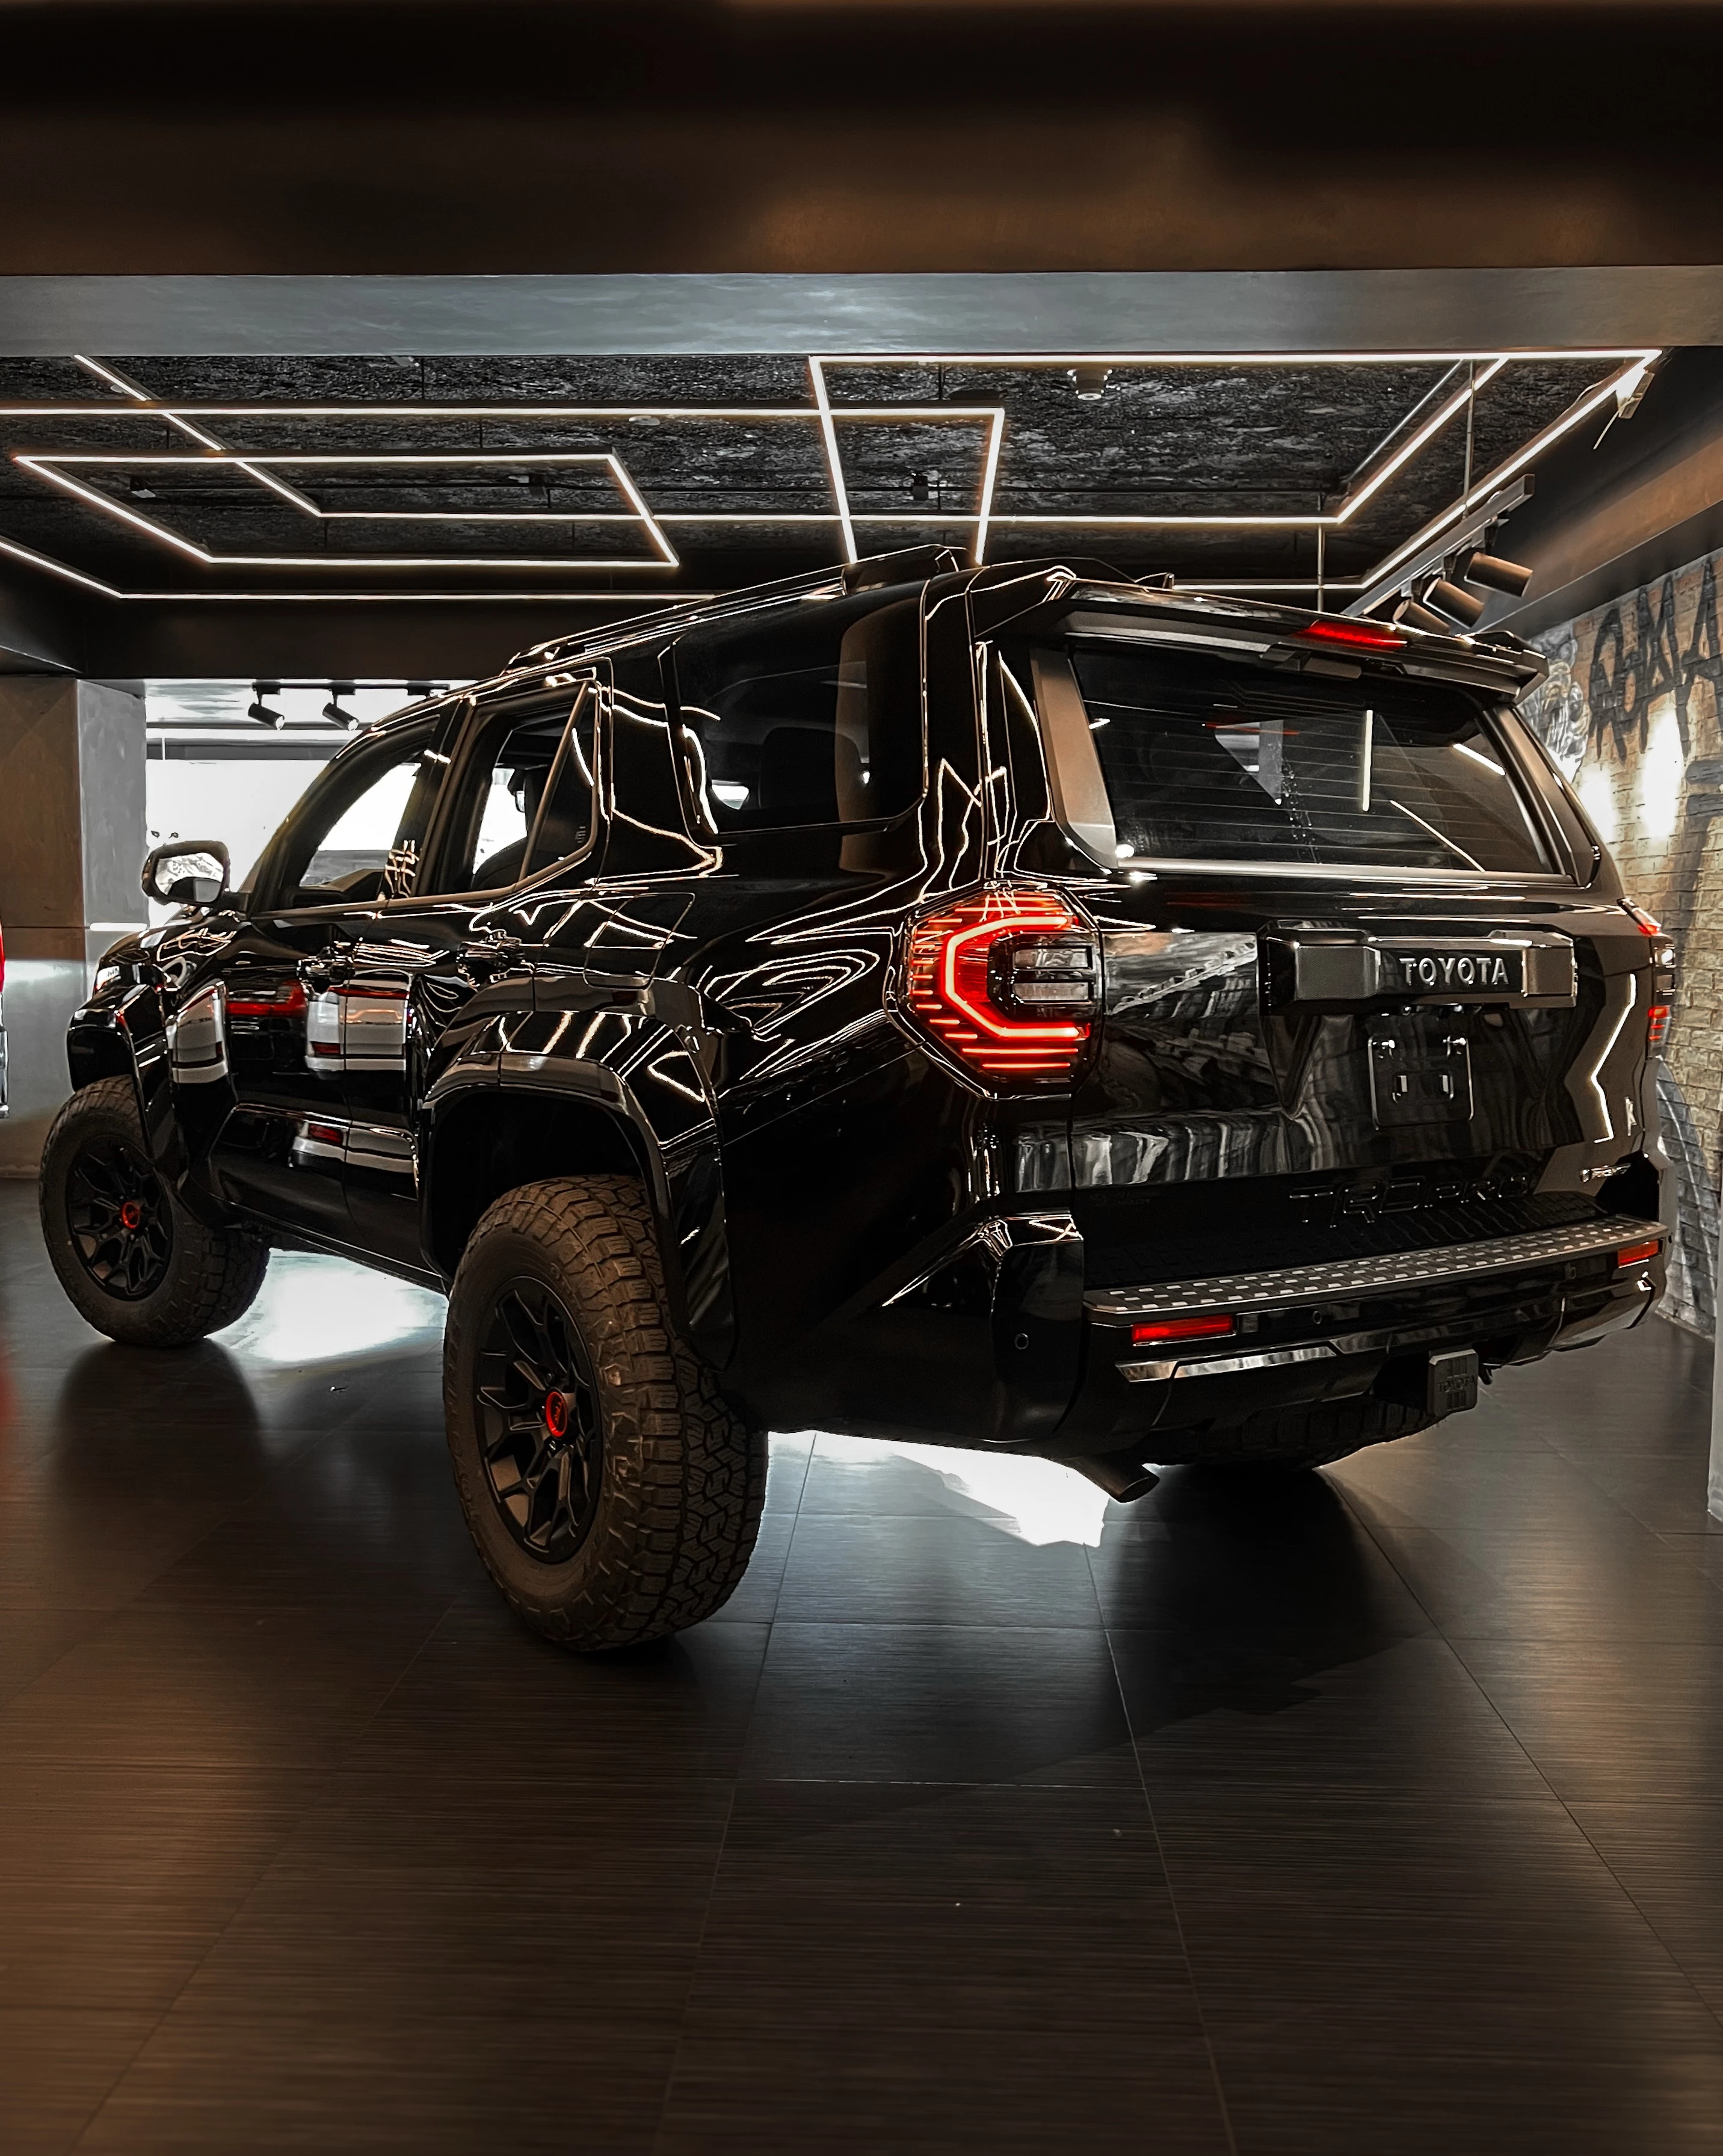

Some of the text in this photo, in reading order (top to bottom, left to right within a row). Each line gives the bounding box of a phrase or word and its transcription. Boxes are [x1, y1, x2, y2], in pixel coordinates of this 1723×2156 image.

[1399, 957, 1509, 986] TOYOTA
[1289, 1175, 1426, 1228] TRD
[1423, 1172, 1529, 1208] PRO
[1437, 1375, 1476, 1393] TOYOTA
